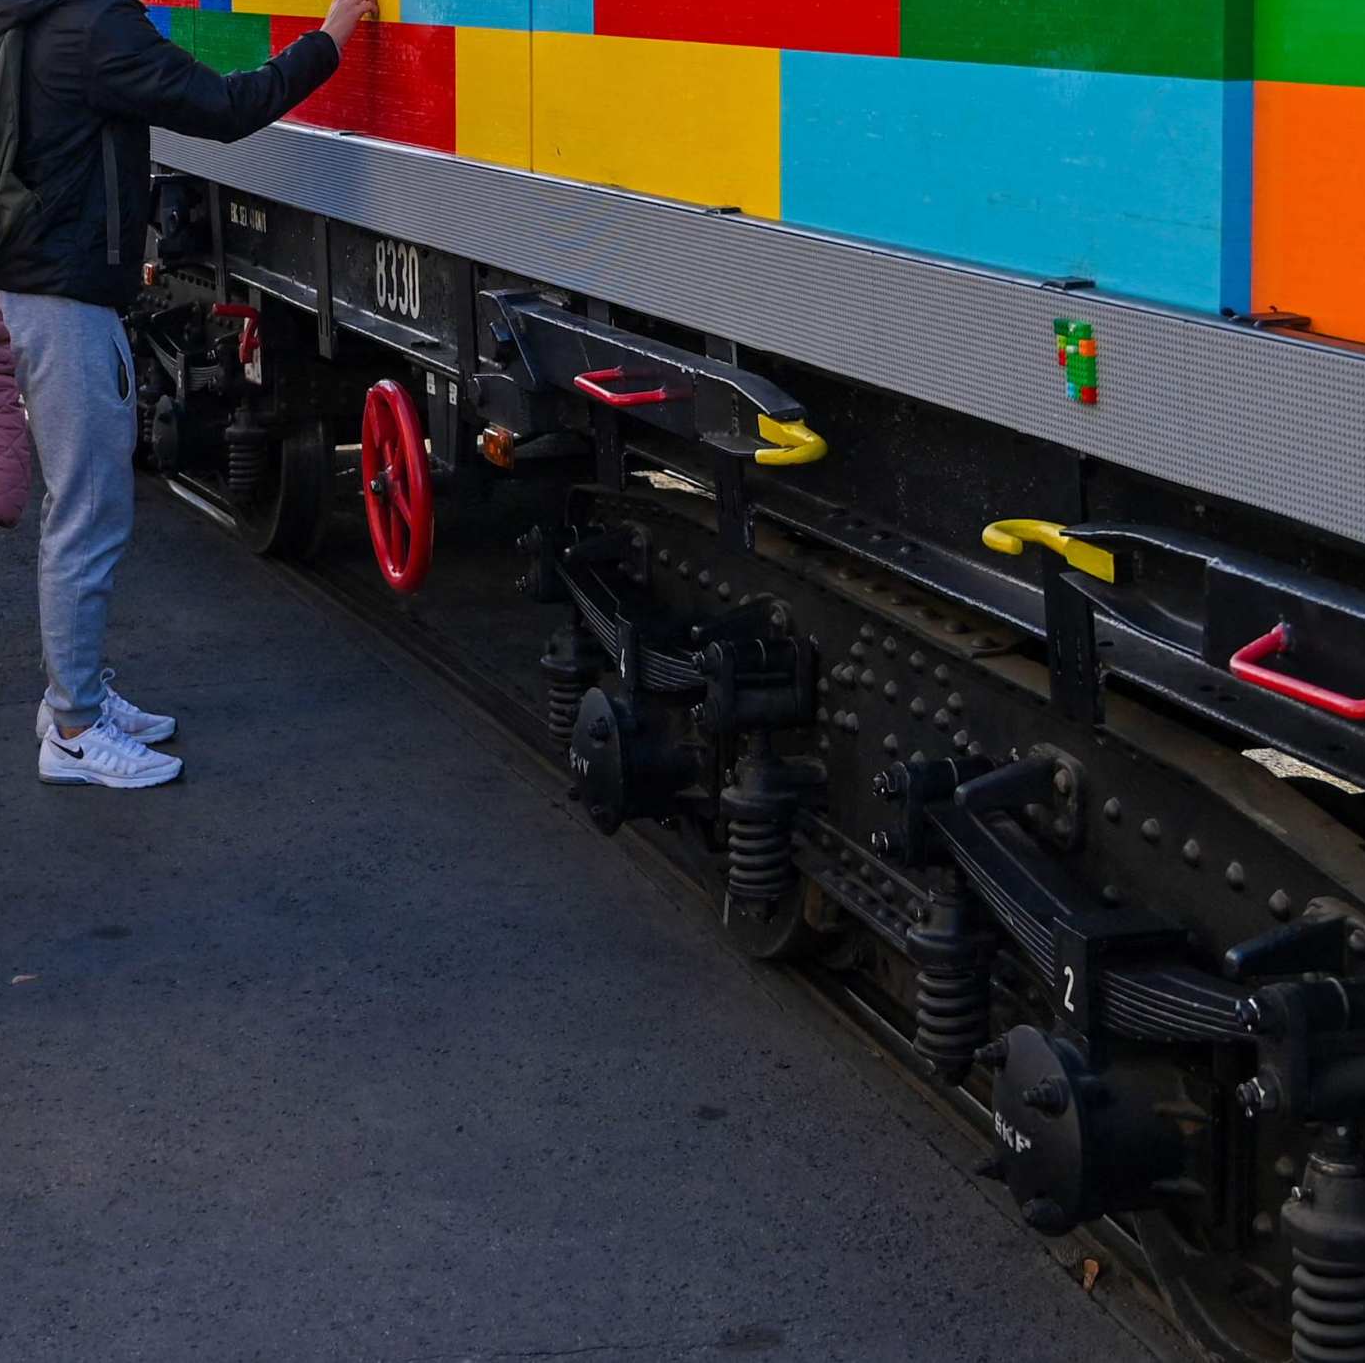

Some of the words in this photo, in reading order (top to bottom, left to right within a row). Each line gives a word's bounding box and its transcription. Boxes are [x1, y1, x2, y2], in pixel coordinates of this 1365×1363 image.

[375, 239, 421, 320] 8330
[1063, 965, 1075, 1013] 2
[994, 1110, 1032, 1154] SKF
